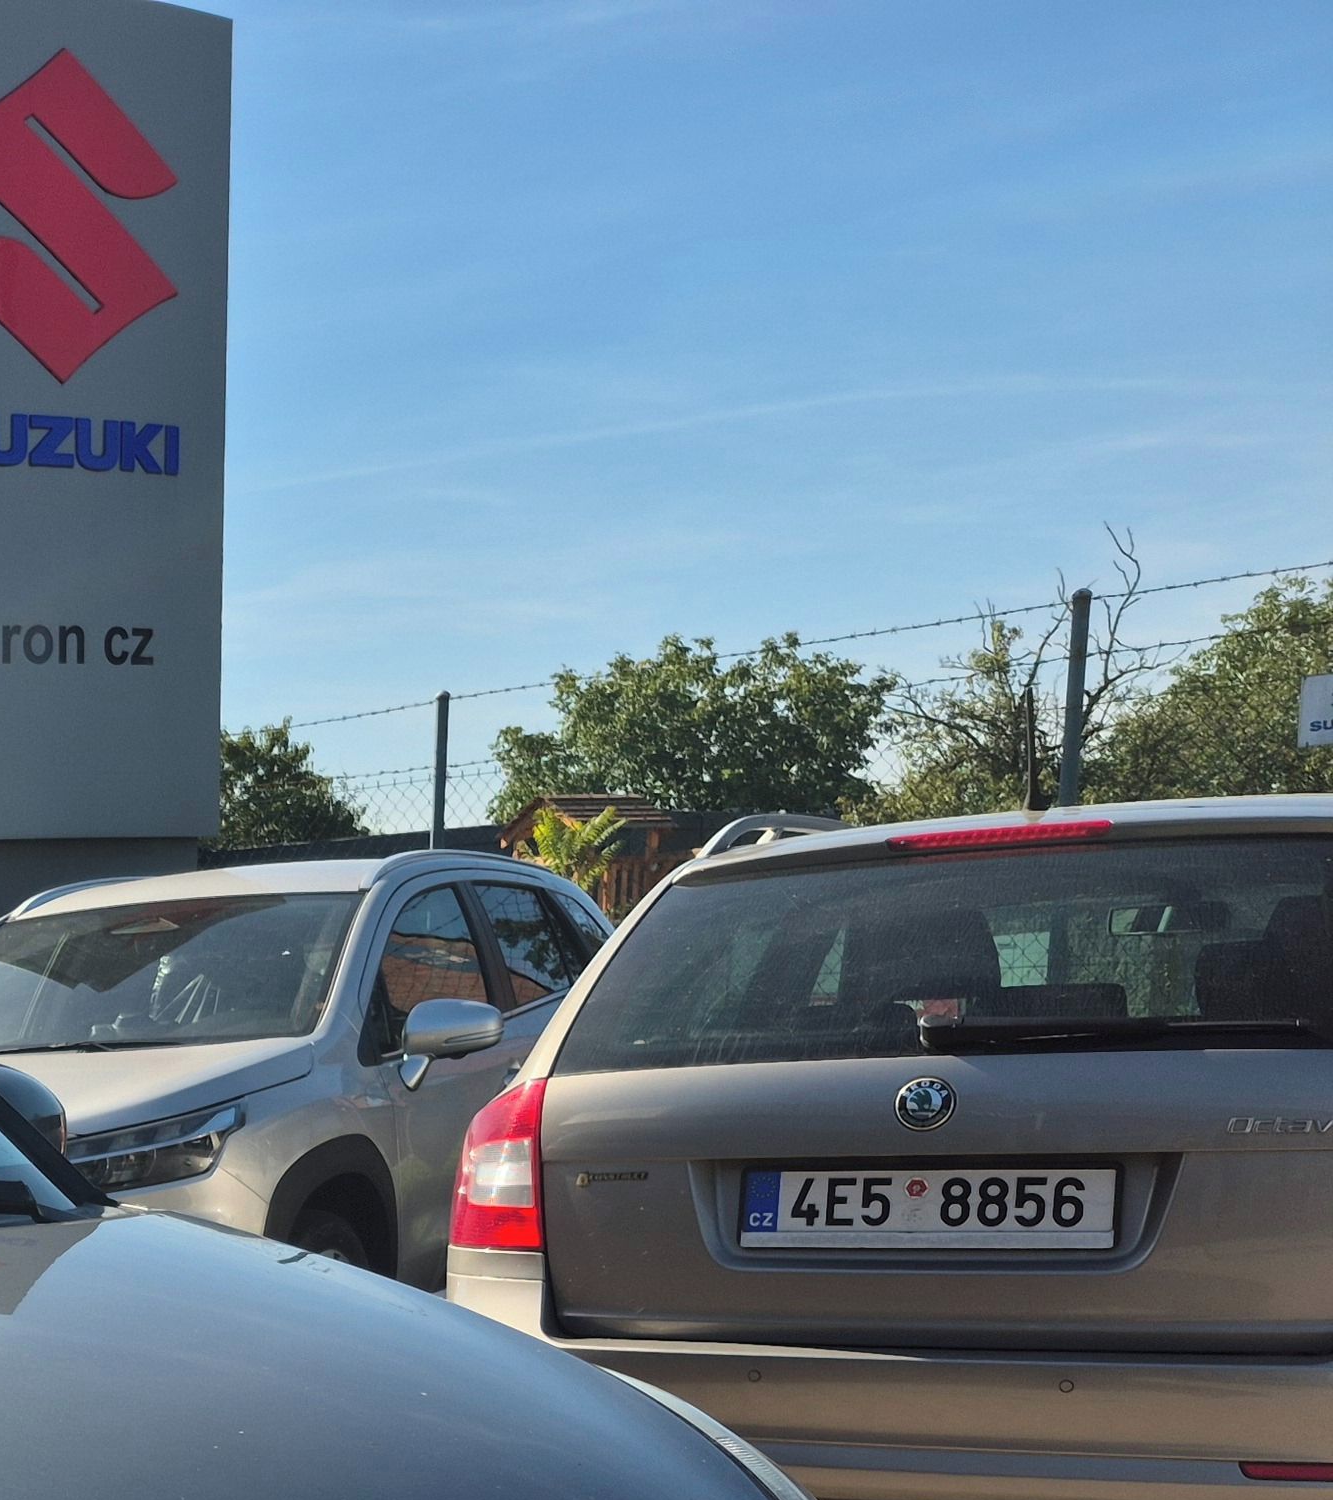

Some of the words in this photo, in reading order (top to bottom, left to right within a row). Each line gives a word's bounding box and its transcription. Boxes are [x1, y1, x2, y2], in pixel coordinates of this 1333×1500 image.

[103, 625, 155, 666] cz
[749, 1212, 774, 1227] CZ
[790, 1177, 893, 1227] 4E5
[939, 1176, 1086, 1228] 8856
